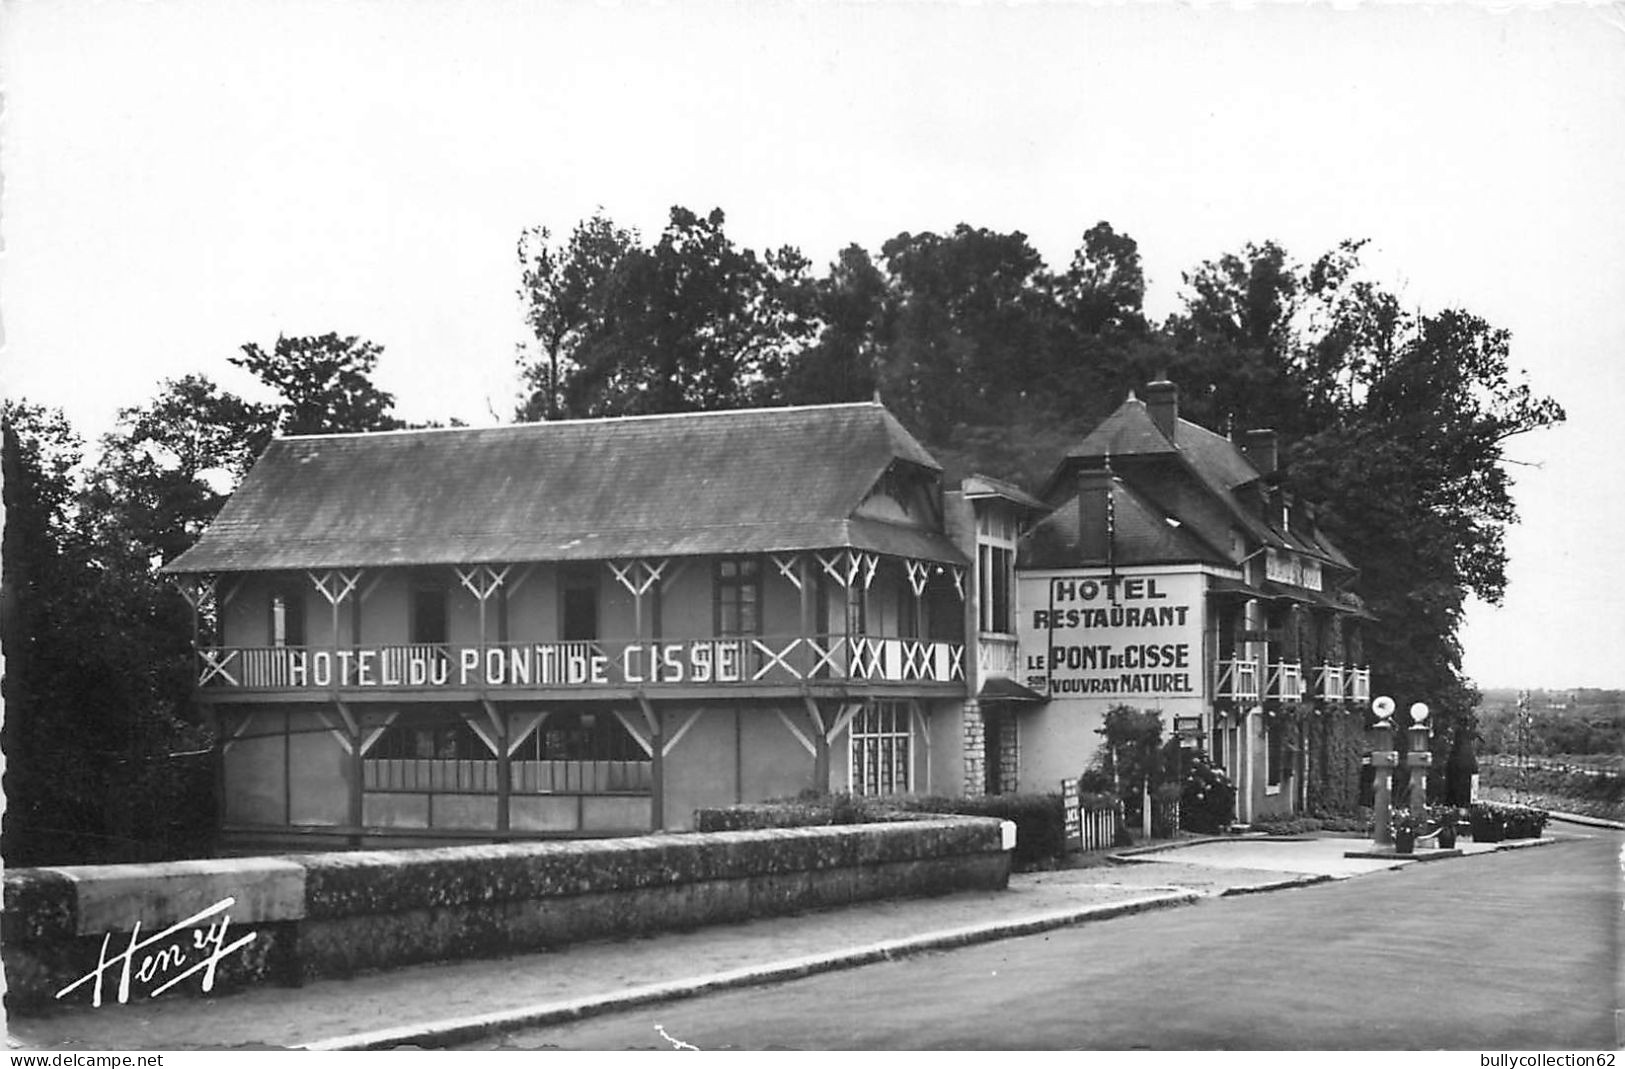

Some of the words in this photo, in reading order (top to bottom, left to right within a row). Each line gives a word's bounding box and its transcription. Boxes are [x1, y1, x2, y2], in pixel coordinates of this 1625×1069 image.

[1056, 578, 1167, 602] HOTEL
[1033, 606, 1189, 630] RESTAURANT
[288, 651, 396, 687] HOTEL
[460, 647, 555, 685] PONT
[623, 642, 740, 683] CISSE
[1027, 655, 1045, 671] LE
[1052, 645, 1111, 670] PONT
[1109, 654, 1125, 668] DE
[1124, 644, 1189, 669] CISSE
[1051, 677, 1120, 694] VOUVRAY
[1120, 673, 1194, 693] NATUREL
